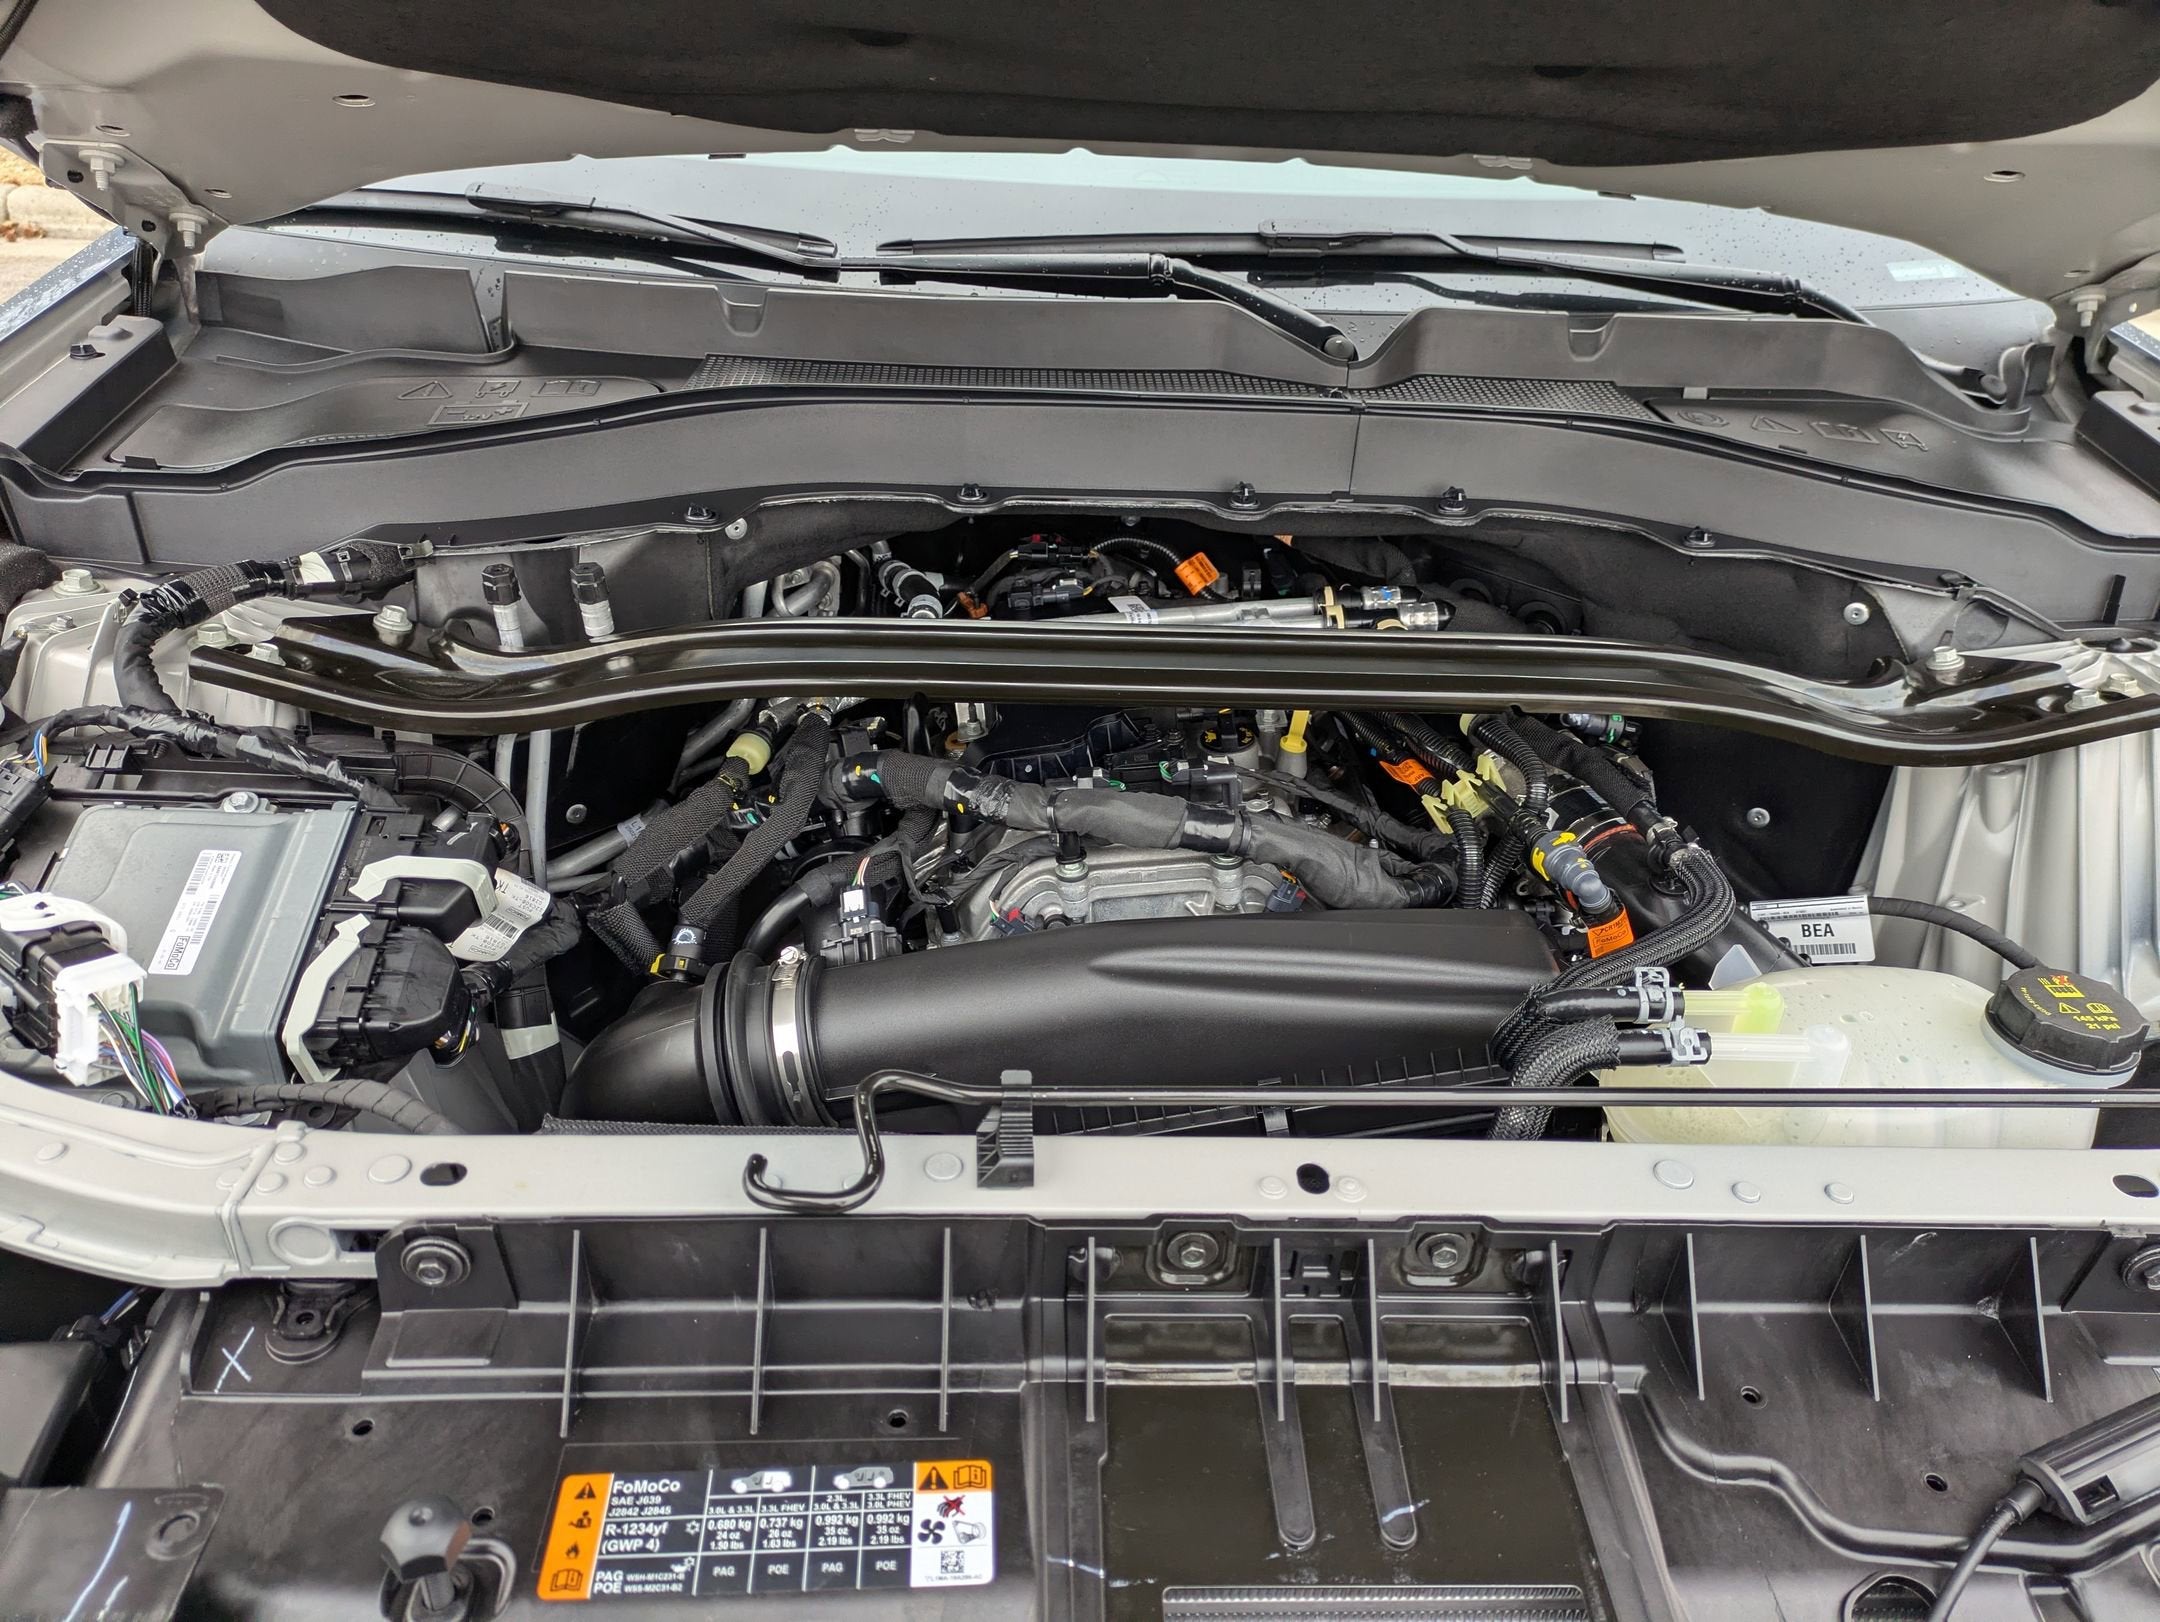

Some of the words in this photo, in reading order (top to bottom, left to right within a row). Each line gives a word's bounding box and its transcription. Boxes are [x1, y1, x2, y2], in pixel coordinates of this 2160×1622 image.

[1801, 924, 1834, 937] BEA
[167, 937, 188, 968] FoMoCo
[613, 1479, 681, 1494] FoMoCo
[611, 1496, 634, 1506] SAE
[636, 1495, 661, 1505] J639
[887, 1492, 911, 1500] FHEV
[708, 1506, 726, 1514] 3.0L
[728, 1505, 735, 1513] &
[737, 1505, 754, 1513] 3.3L
[761, 1504, 779, 1513] 3.3L
[781, 1503, 805, 1512] FHEV
[813, 1503, 831, 1511] 3.0L
[833, 1502, 840, 1510] &
[841, 1501, 860, 1510] 3.3L
[887, 1500, 911, 1508] PHEV
[608, 1507, 639, 1517] J2842
[641, 1506, 671, 1515] J2845
[707, 1519, 736, 1531] 0.680
[738, 1519, 752, 1531] kg
[760, 1517, 788, 1529] 0.737
[789, 1517, 804, 1530] kg
[815, 1515, 844, 1526] 0.992
[845, 1514, 859, 1527] kg
[867, 1513, 895, 1525] 0.992
[896, 1513, 910, 1526] kg
[605, 1522, 668, 1537] R-1234yf
[768, 1529, 779, 1538] 26
[781, 1530, 793, 1538] oz
[824, 1527, 835, 1536] 35
[837, 1527, 849, 1535] oz
[876, 1525, 887, 1534] 35
[888, 1526, 900, 1534] oz
[716, 1531, 727, 1540] 24
[729, 1532, 741, 1540] oz
[818, 1537, 838, 1546] 2.19
[839, 1536, 853, 1545] lbs
[870, 1535, 889, 1545] 2.19
[891, 1535, 905, 1544] lbs
[602, 1539, 643, 1554] (GWP
[645, 1538, 660, 1552] 4)
[730, 1541, 744, 1550] lbs
[782, 1539, 797, 1548] lbs
[767, 1564, 789, 1575] POE
[822, 1562, 843, 1573] PAG
[876, 1560, 897, 1571] POE
[596, 1570, 623, 1583] PAG
[713, 1566, 735, 1577] PAG
[593, 1581, 622, 1594] POE
